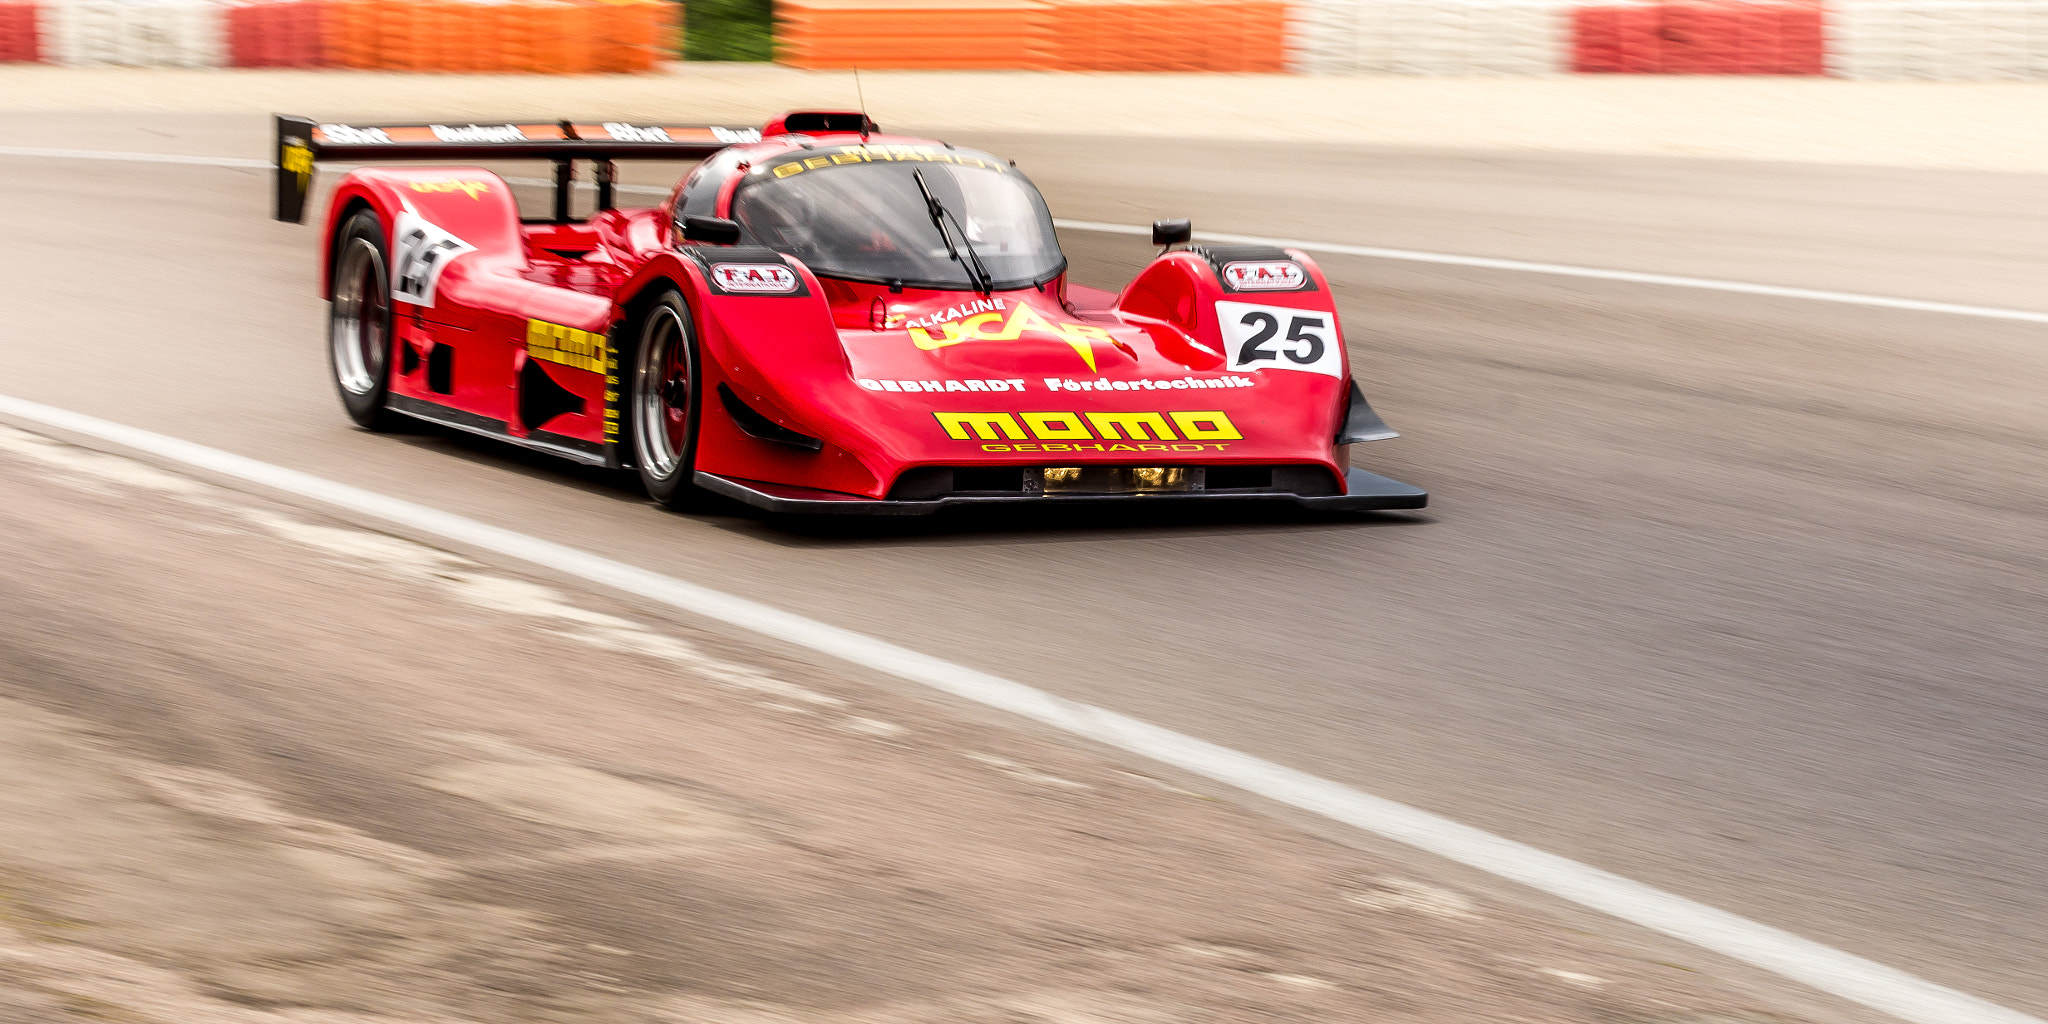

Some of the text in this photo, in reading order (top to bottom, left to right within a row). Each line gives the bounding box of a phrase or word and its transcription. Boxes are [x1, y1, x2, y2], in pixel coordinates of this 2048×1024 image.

[906, 298, 1006, 329] ALKALINE
[907, 301, 1116, 374] UCAR
[1236, 311, 1325, 366] 25
[859, 375, 1255, 393] GEBHARDT Fördertechnik
[981, 443, 1230, 453] GEBHARDT
